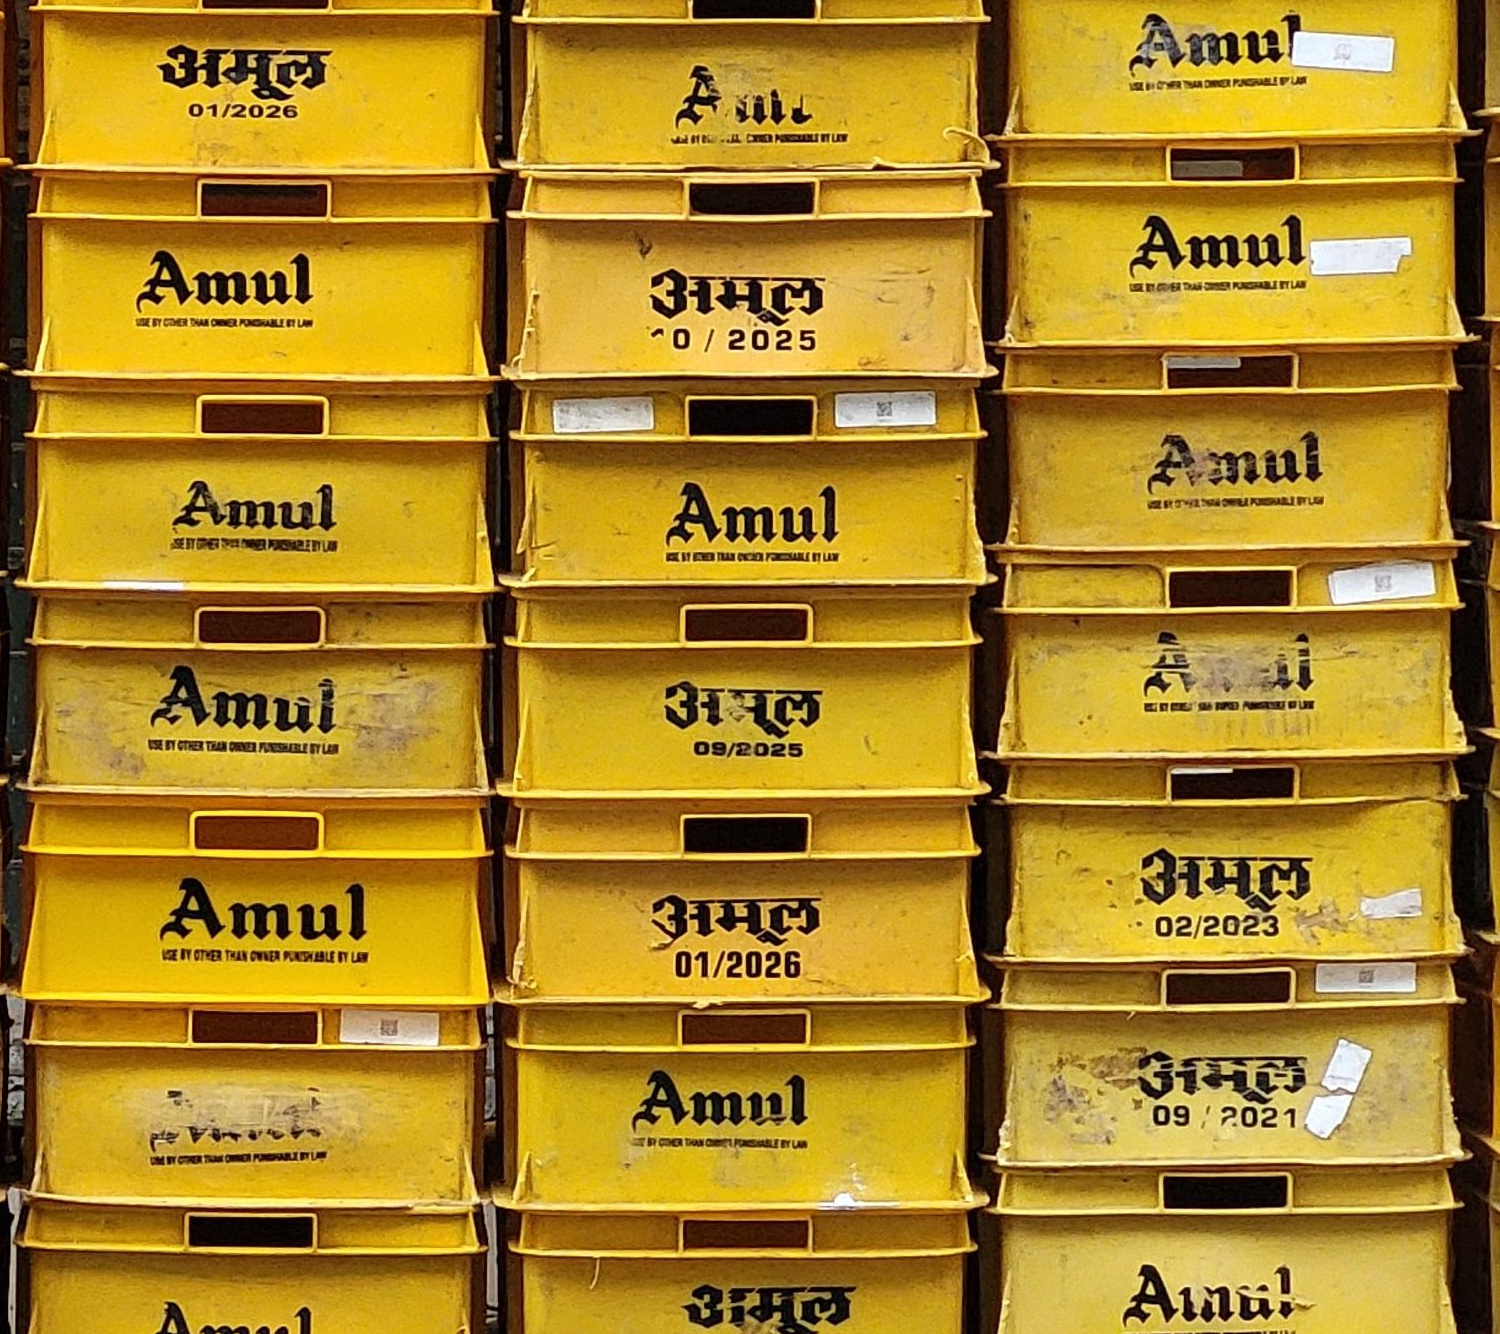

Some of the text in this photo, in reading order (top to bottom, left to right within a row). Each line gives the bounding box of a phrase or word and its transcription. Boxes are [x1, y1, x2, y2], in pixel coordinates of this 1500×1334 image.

[157, 44, 332, 100] अमूल
[188, 103, 298, 119] 01/2026
[1130, 213, 1306, 276] Amul
[136, 249, 312, 313] Amul
[651, 268, 824, 325] अमूल
[1147, 430, 1322, 493] Amul
[173, 480, 334, 531] Amul
[666, 483, 839, 545] Amul
[150, 665, 334, 736] Amul
[693, 742, 803, 758] 09/2025
[1140, 847, 1313, 912] अमूल
[160, 877, 367, 941] Amul
[651, 892, 821, 948] अमूल
[1155, 914, 1280, 938] 02/2023
[162, 948, 178, 962] USE
[225, 949, 248, 963] THAN
[351, 950, 369, 964] LAW
[675, 950, 801, 978] 01/2026
[631, 1070, 808, 1130] Amul
[1138, 1050, 1307, 1104] अमूल
